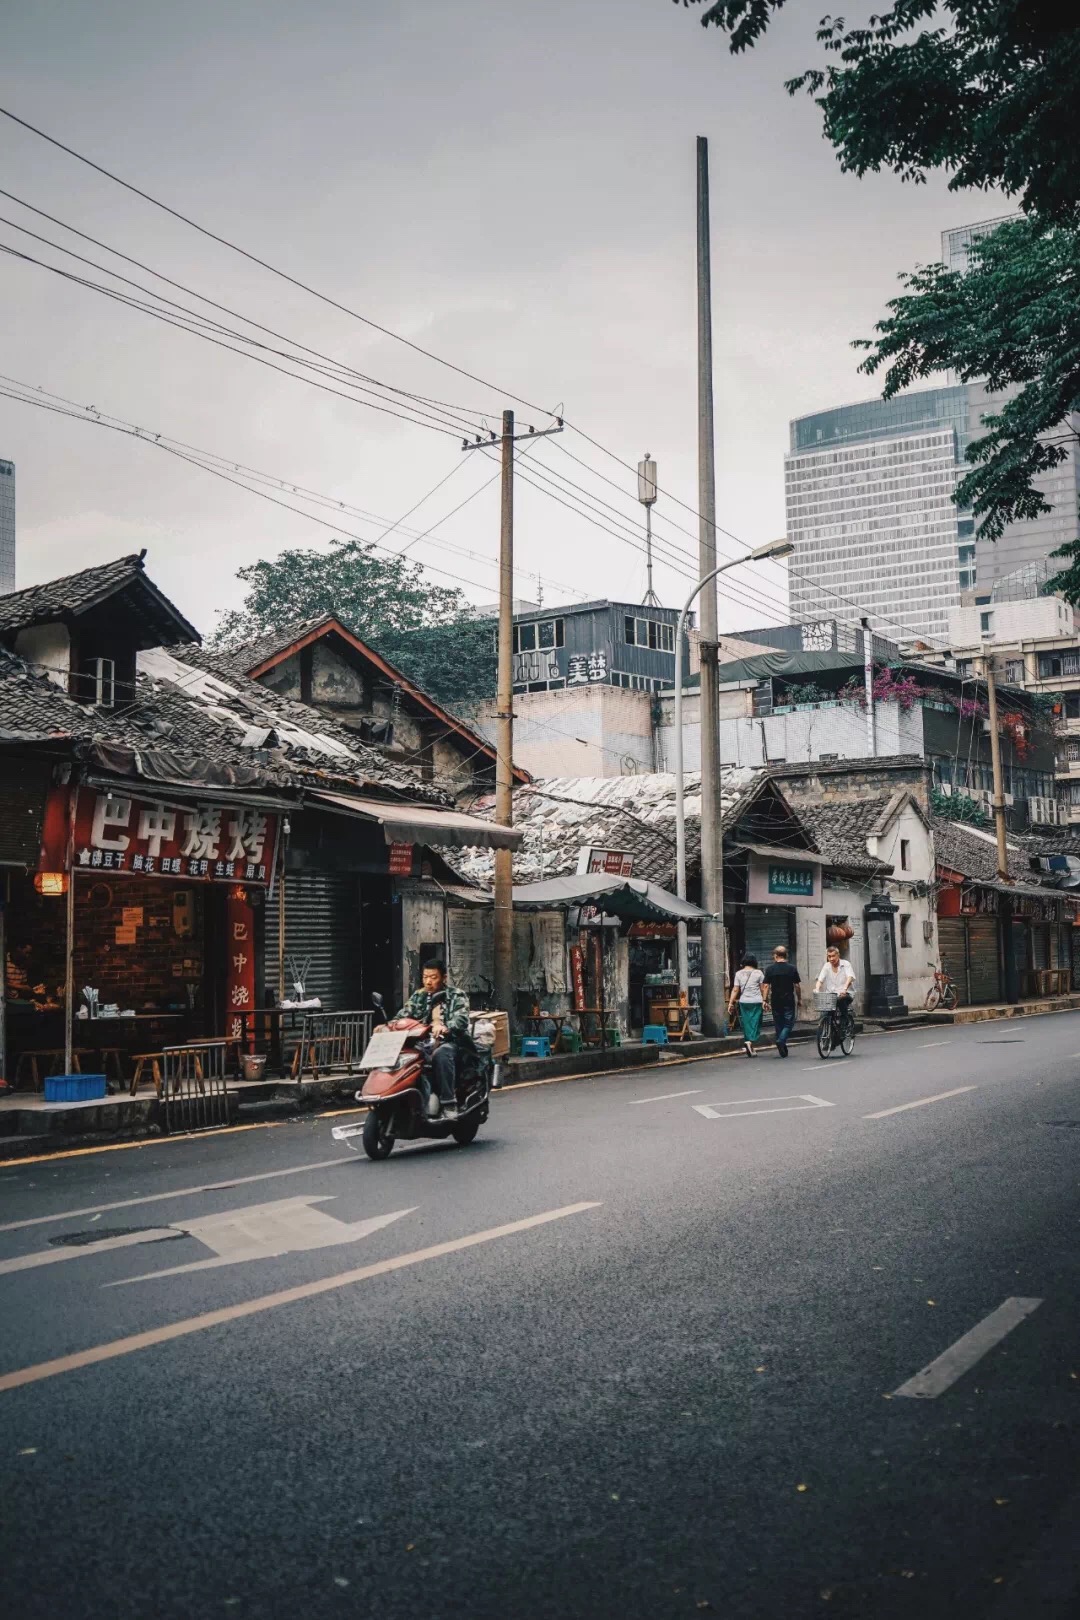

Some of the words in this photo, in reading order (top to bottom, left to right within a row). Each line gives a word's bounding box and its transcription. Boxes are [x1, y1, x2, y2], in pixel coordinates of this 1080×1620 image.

[90, 795, 268, 864] 巴中烧烤
[133, 854, 155, 872] 脑花
[161, 857, 182, 873] 田螺
[189, 860, 209, 875] 花甲
[215, 861, 235, 877] 生蚝
[245, 863, 267, 880] 扇贝
